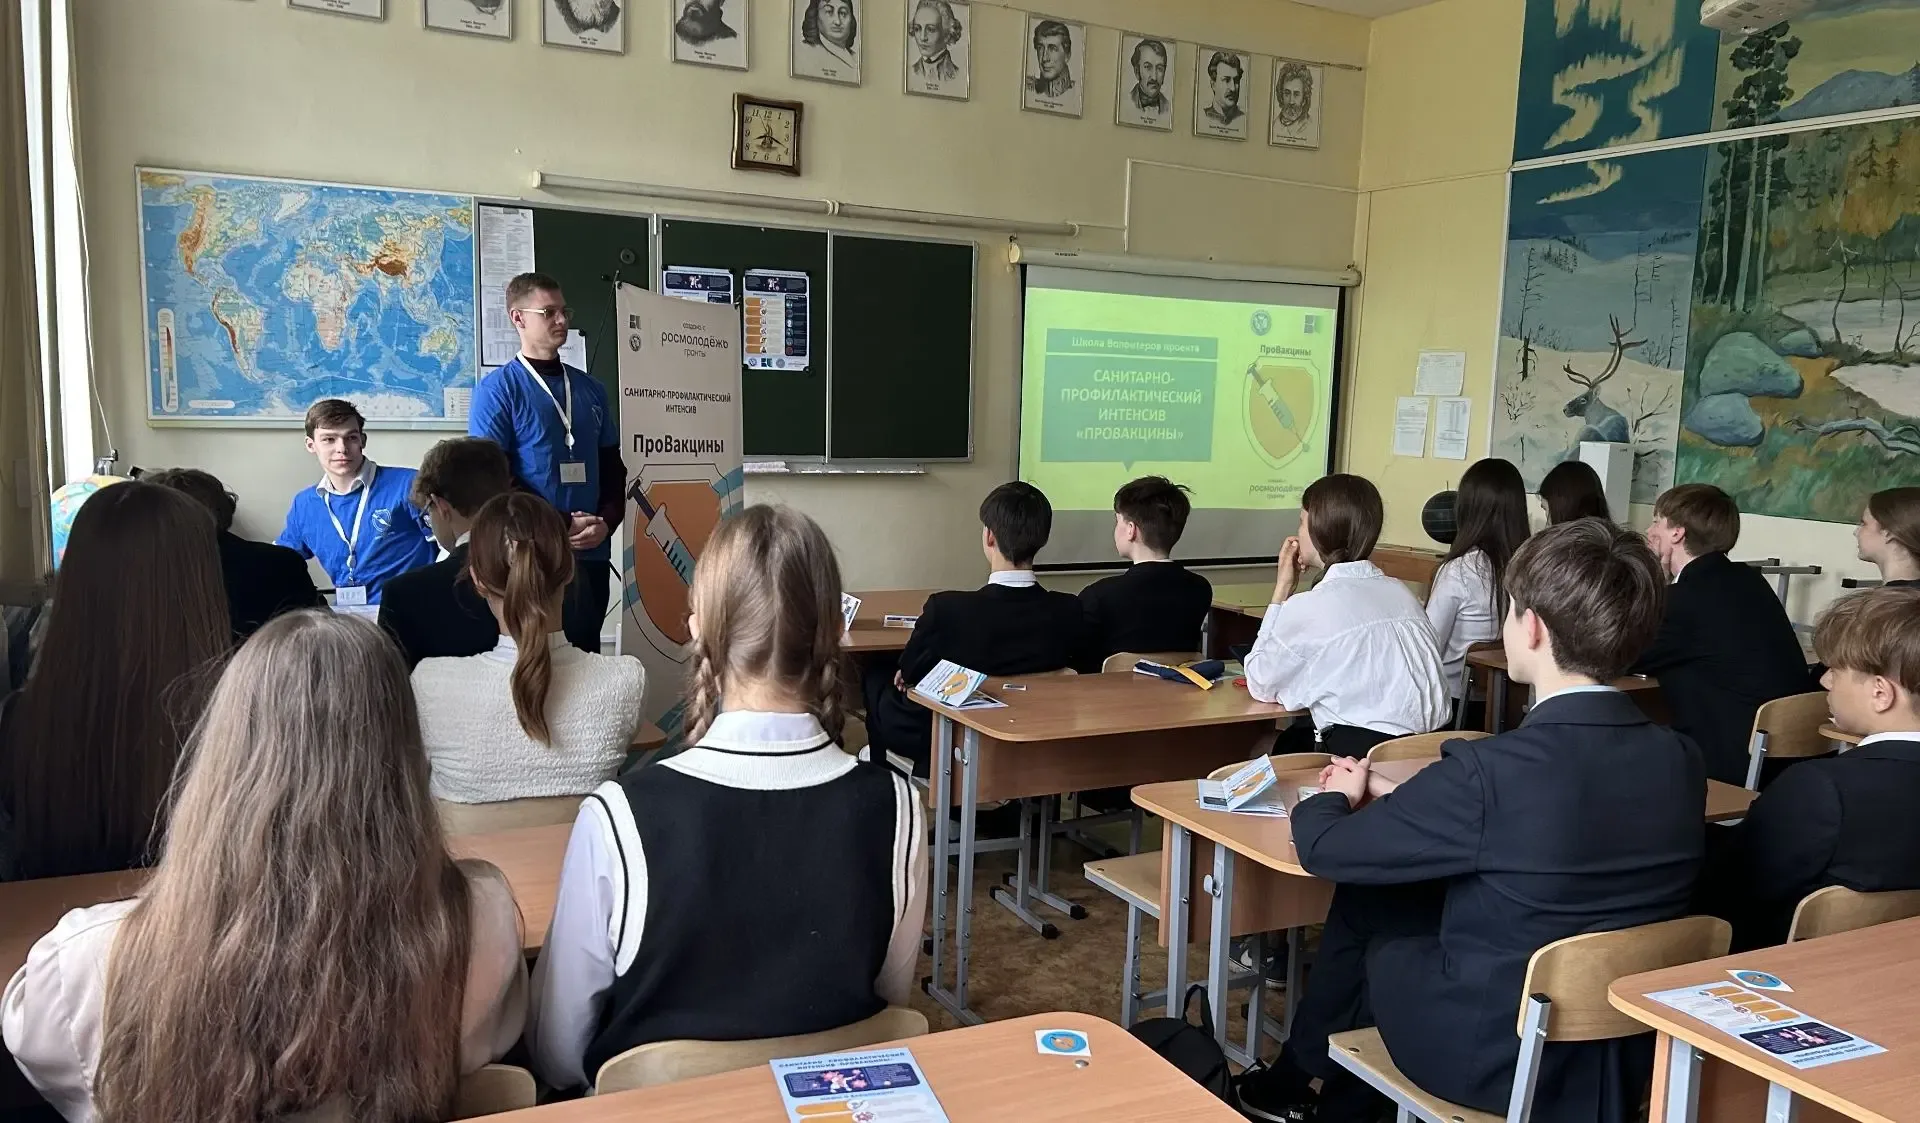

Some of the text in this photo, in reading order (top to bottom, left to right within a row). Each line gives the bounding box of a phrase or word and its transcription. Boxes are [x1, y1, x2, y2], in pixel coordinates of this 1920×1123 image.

[661, 331, 730, 349] росмолодёжь
[1071, 335, 1105, 348] Школа
[1163, 342, 1200, 354] проекта
[1260, 344, 1312, 358] ПроВакцины
[1093, 368, 1176, 385] САНИТАРНО-
[624, 387, 731, 403] САНИТАРНО-ПРОФИЛАКТИЧЕСКИЙ
[1060, 387, 1202, 405] ПРОФИЛАКТИЧЕСКИЙ
[665, 404, 697, 414] ИНТЕНСИВ
[1097, 407, 1167, 421] ИНТЕНСИВ
[1075, 426, 1184, 443] «ПРОВАКЦИНЫ»
[633, 434, 725, 459] ПроВакцины
[1289, 1110, 1304, 1121] NIKE
